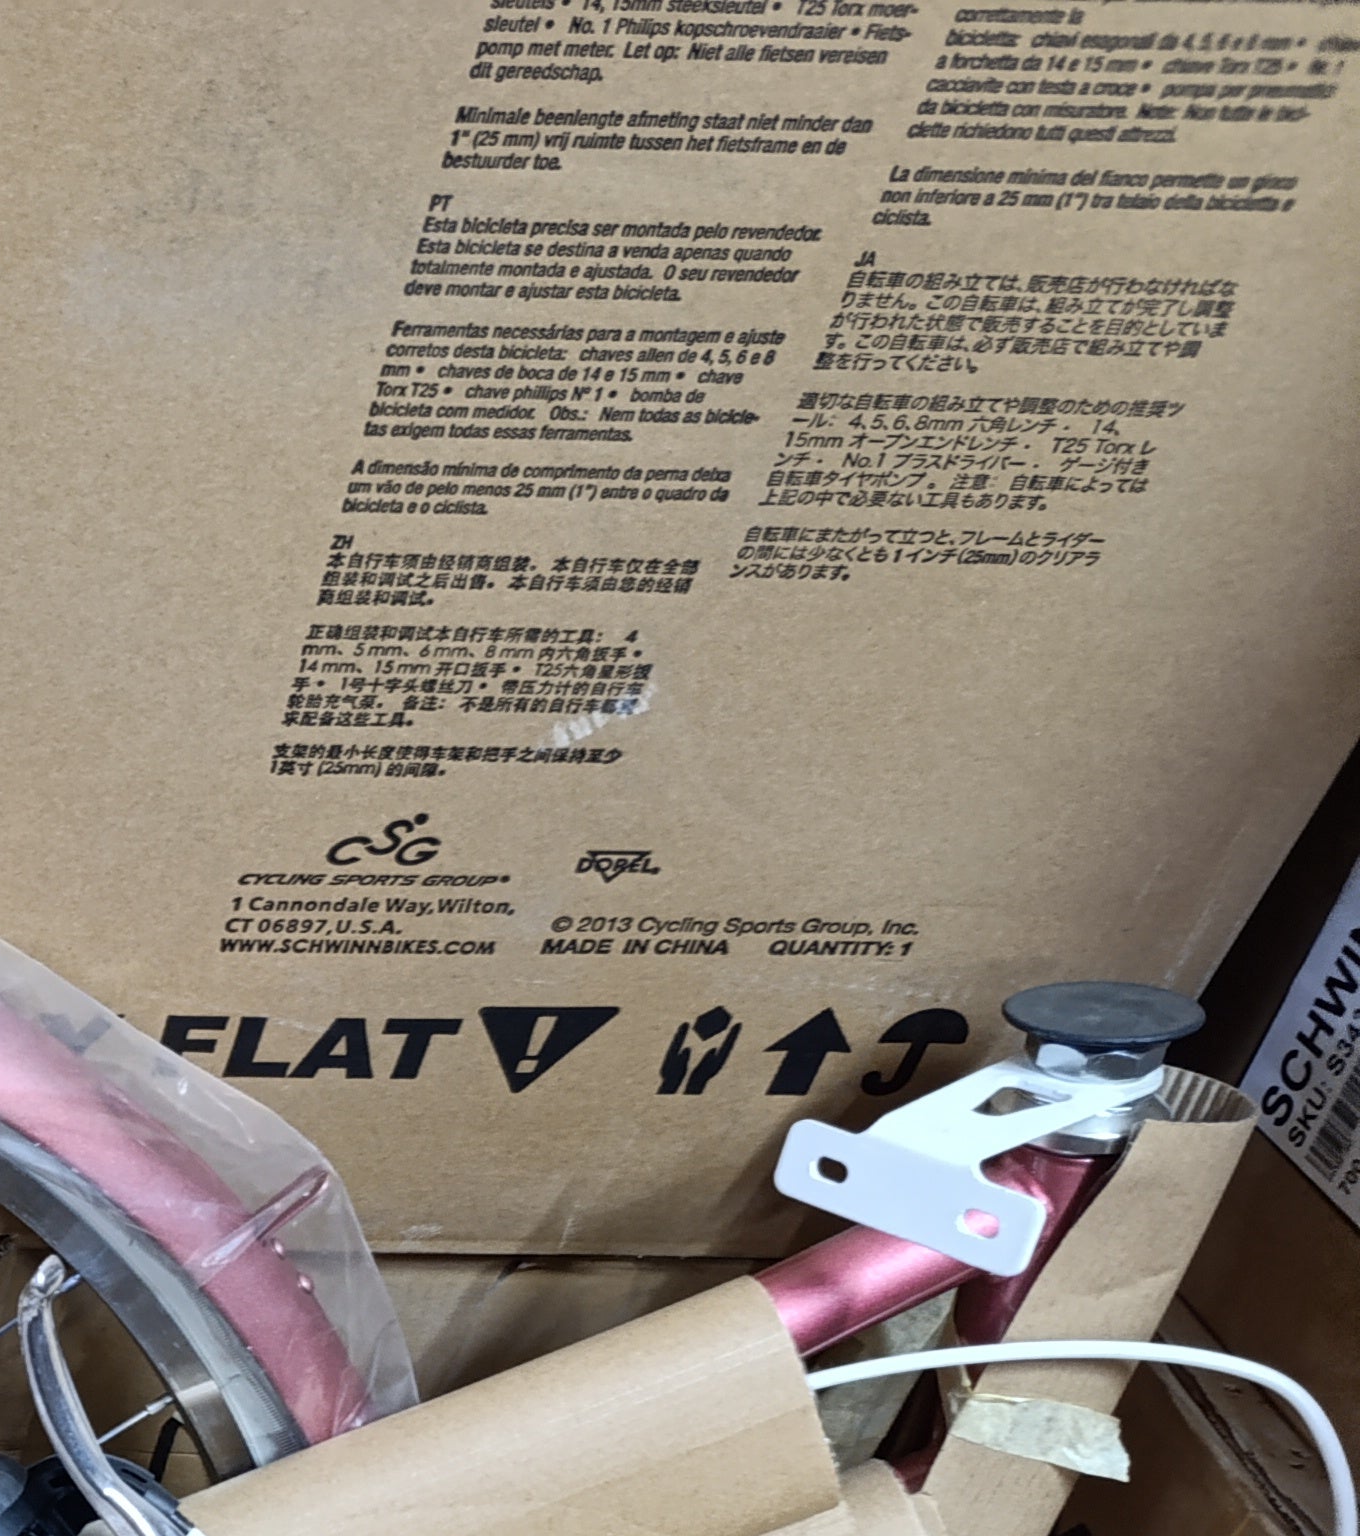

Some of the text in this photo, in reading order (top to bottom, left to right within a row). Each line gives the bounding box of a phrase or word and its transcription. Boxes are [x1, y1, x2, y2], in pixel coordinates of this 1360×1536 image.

[454, 107, 874, 134] Minimale beenlengte afmeting staat niet minder dan
[428, 194, 454, 212] PT
[422, 216, 823, 243] Esta bicicleta precisa ser montada pelo revendedor.
[853, 250, 877, 268] JA
[341, 497, 489, 516] bicicleta e o ciclista.
[329, 534, 355, 551] ZH
[326, 813, 443, 866] CSG
[237, 873, 508, 887] CYCLING SPORTS GROUP
[231, 896, 244, 912] 1
[248, 895, 381, 913] Cannondale
[224, 917, 255, 934] CT
[575, 915, 635, 934] 2013
[637, 916, 720, 937] Cycling
[723, 916, 798, 937] Sports
[800, 917, 874, 938] Group,
[880, 919, 920, 936] Inc.
[219, 937, 497, 956] WWW.SCHWINNBIKES.COM
[540, 938, 729, 956] MADE IN CHINA
[767, 939, 914, 957] QUANTITY: 1
